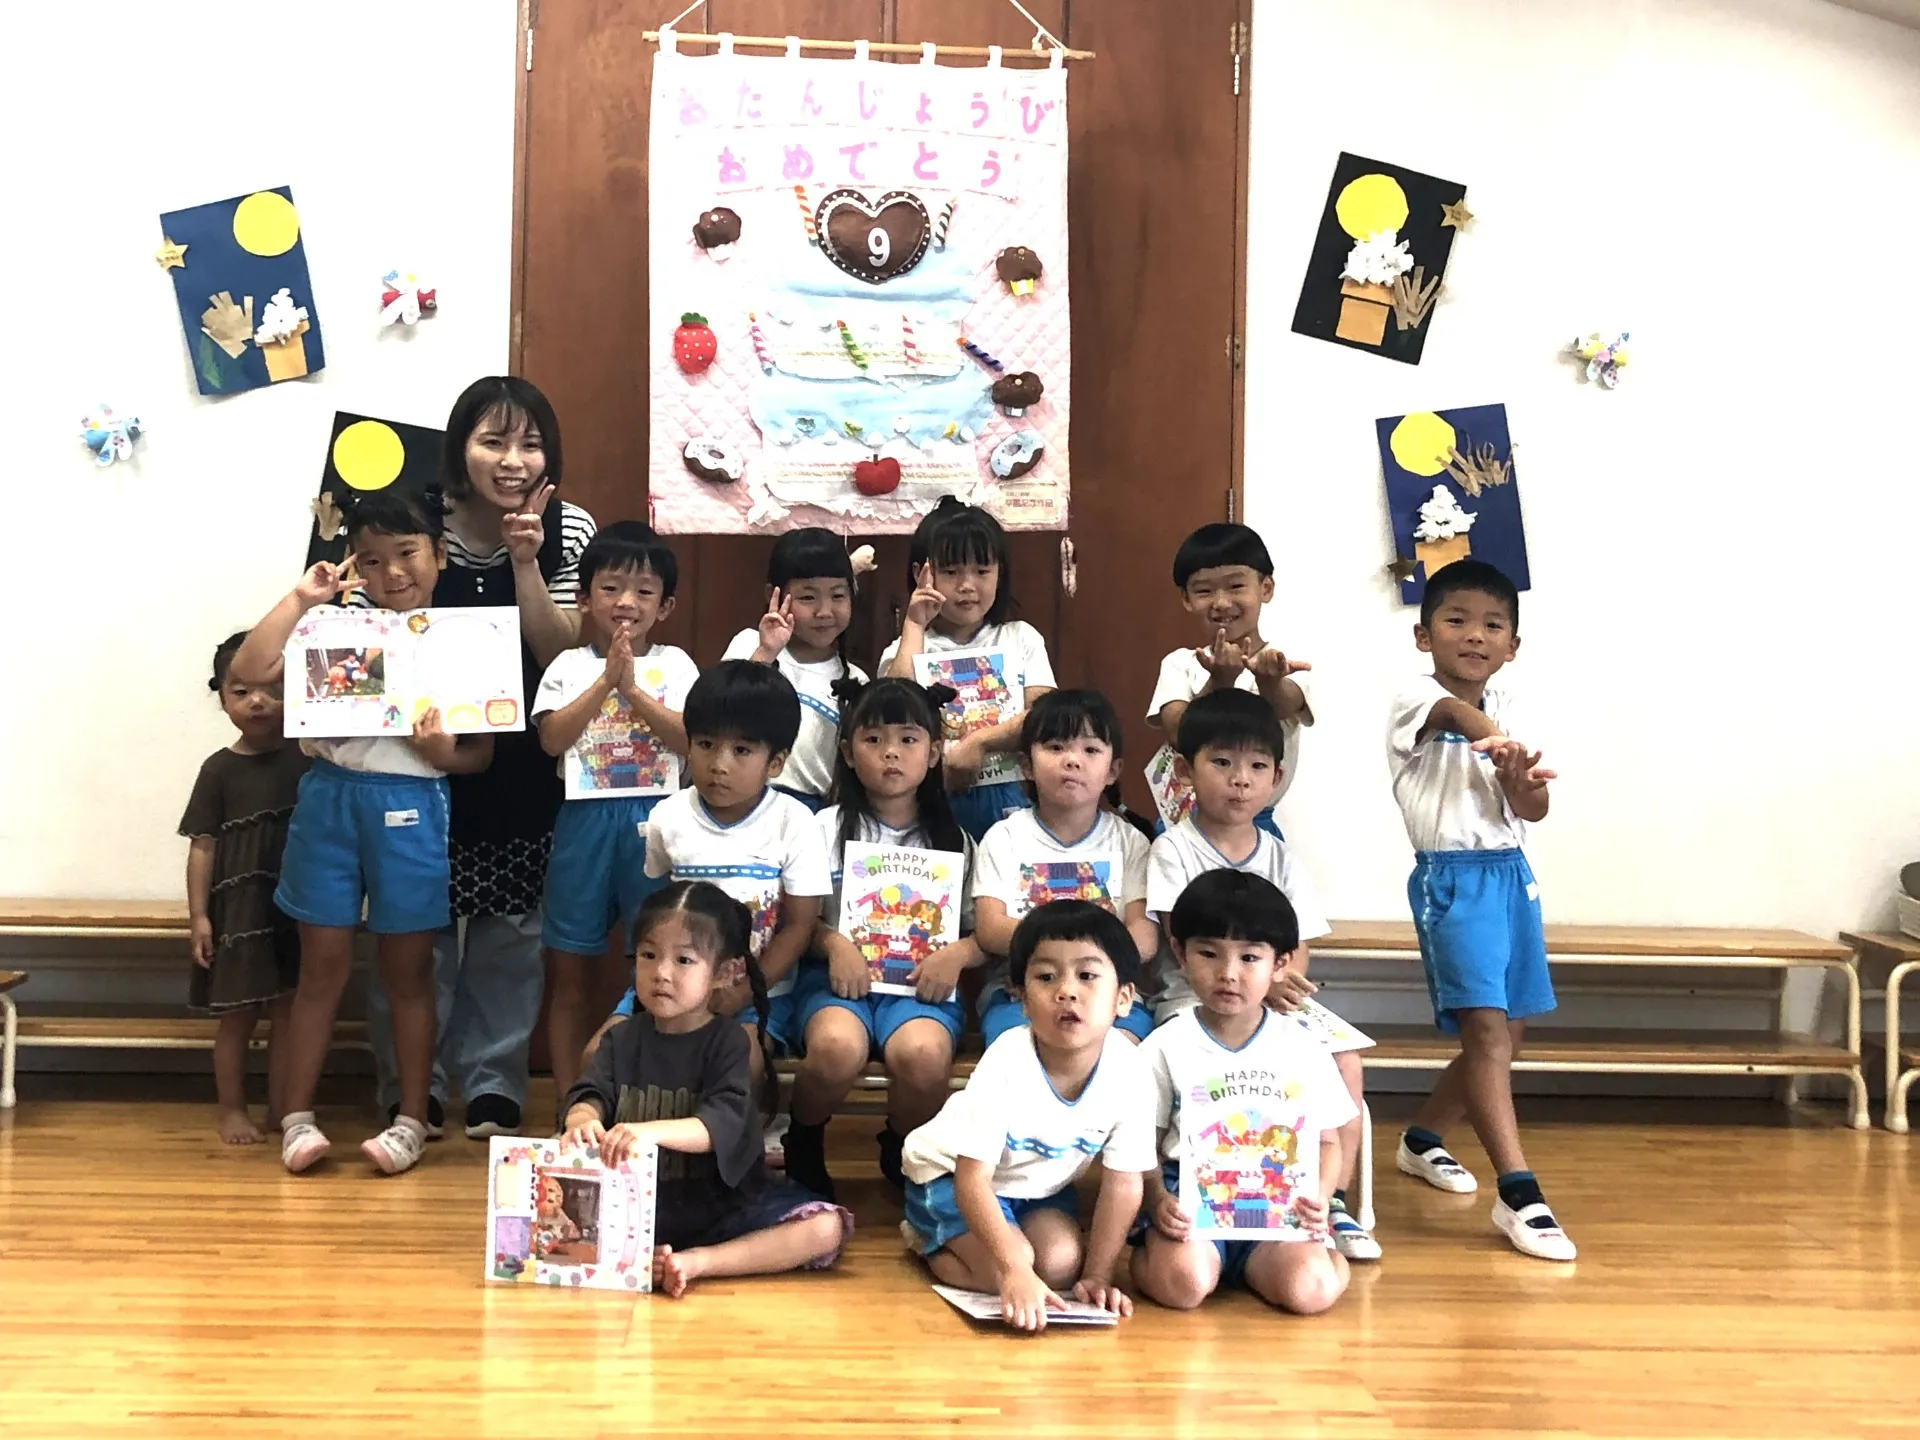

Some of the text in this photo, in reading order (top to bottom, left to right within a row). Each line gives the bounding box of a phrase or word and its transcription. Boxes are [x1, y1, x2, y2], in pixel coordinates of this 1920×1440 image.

[679, 78, 1055, 134] おたんじょうび
[718, 142, 1002, 187] おめでとう
[867, 227, 891, 267] 9
[978, 766, 1003, 780] HAP
[881, 852, 928, 865] HAPPY
[868, 864, 939, 883] BIRTHDAY
[1224, 1070, 1276, 1083] HAPPY
[1208, 1084, 1291, 1102] BIRTHDAY
